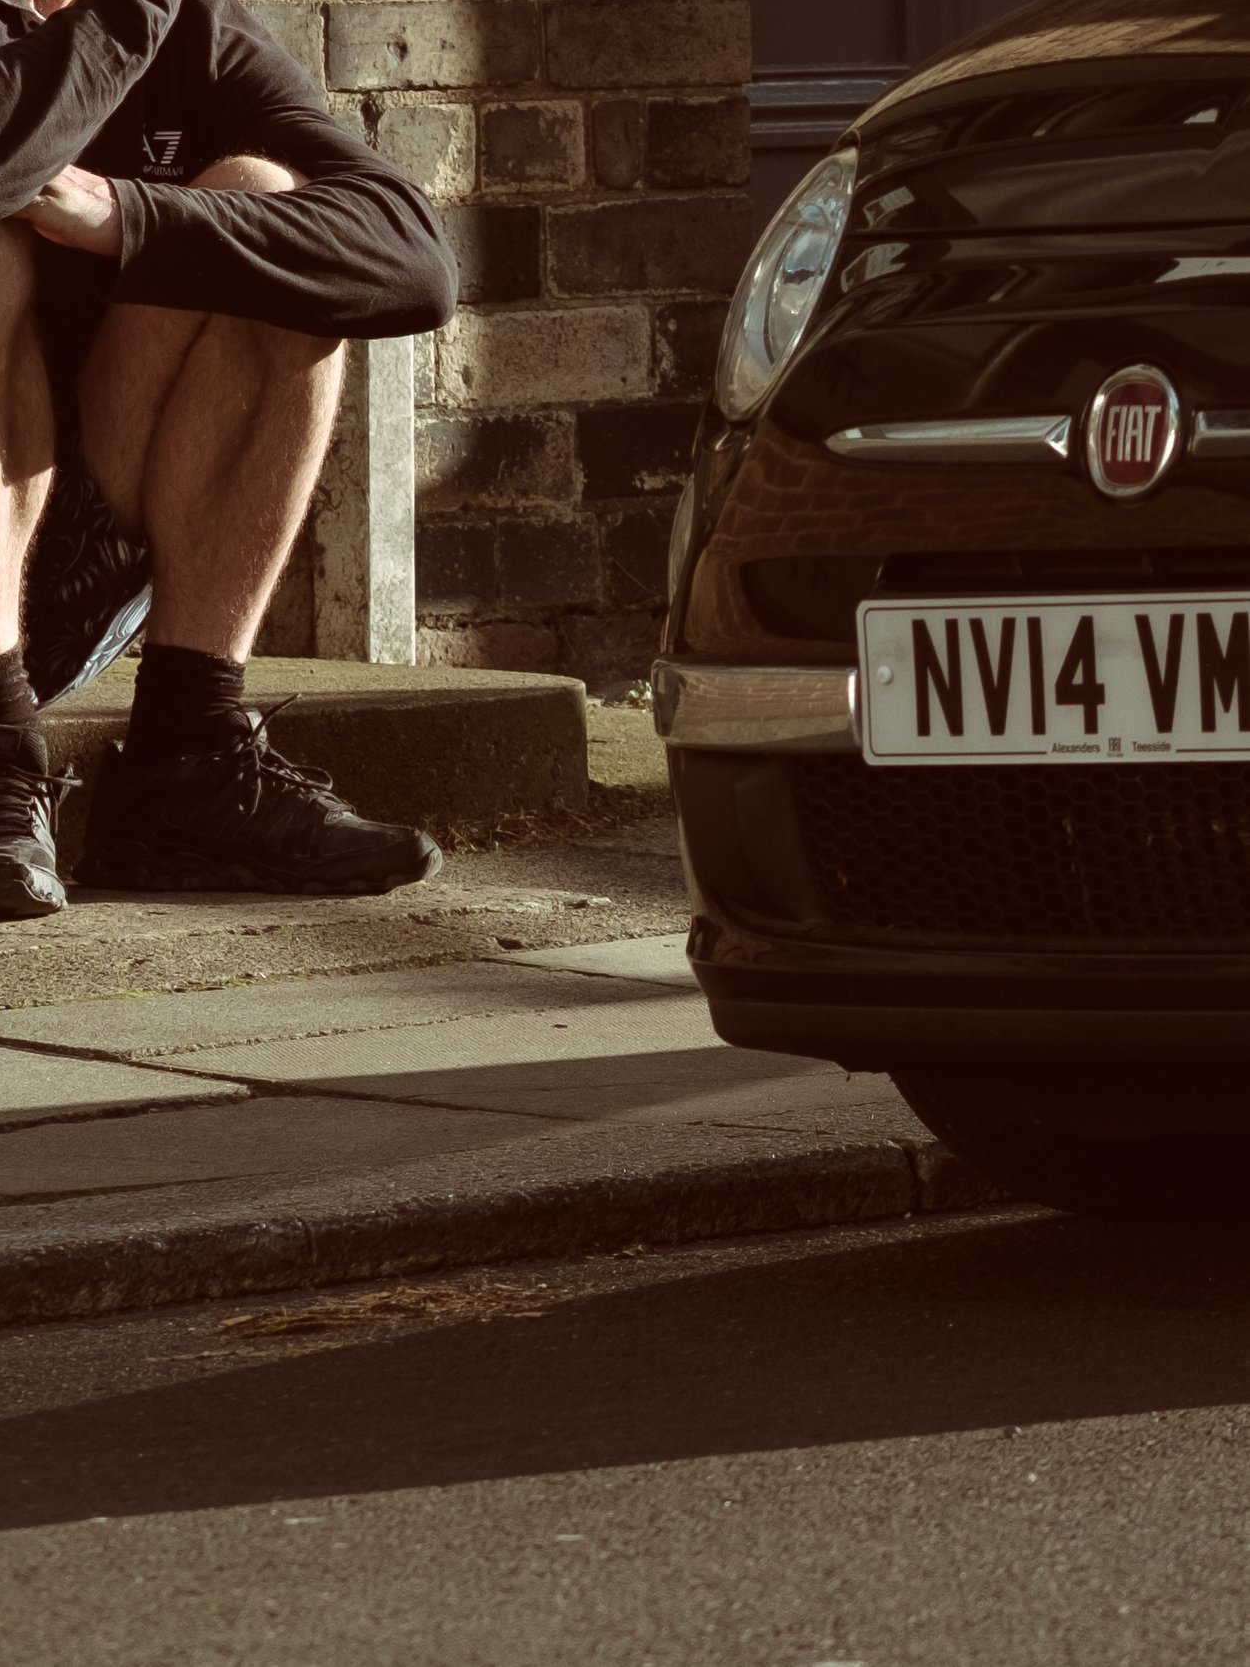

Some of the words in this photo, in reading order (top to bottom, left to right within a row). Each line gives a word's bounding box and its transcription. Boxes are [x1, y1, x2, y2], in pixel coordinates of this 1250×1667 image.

[1105, 404, 1163, 463] FIAT
[911, 615, 1106, 737] NV14
[1052, 742, 1101, 754] Alexanders
[1132, 740, 1172, 753] Teesside
